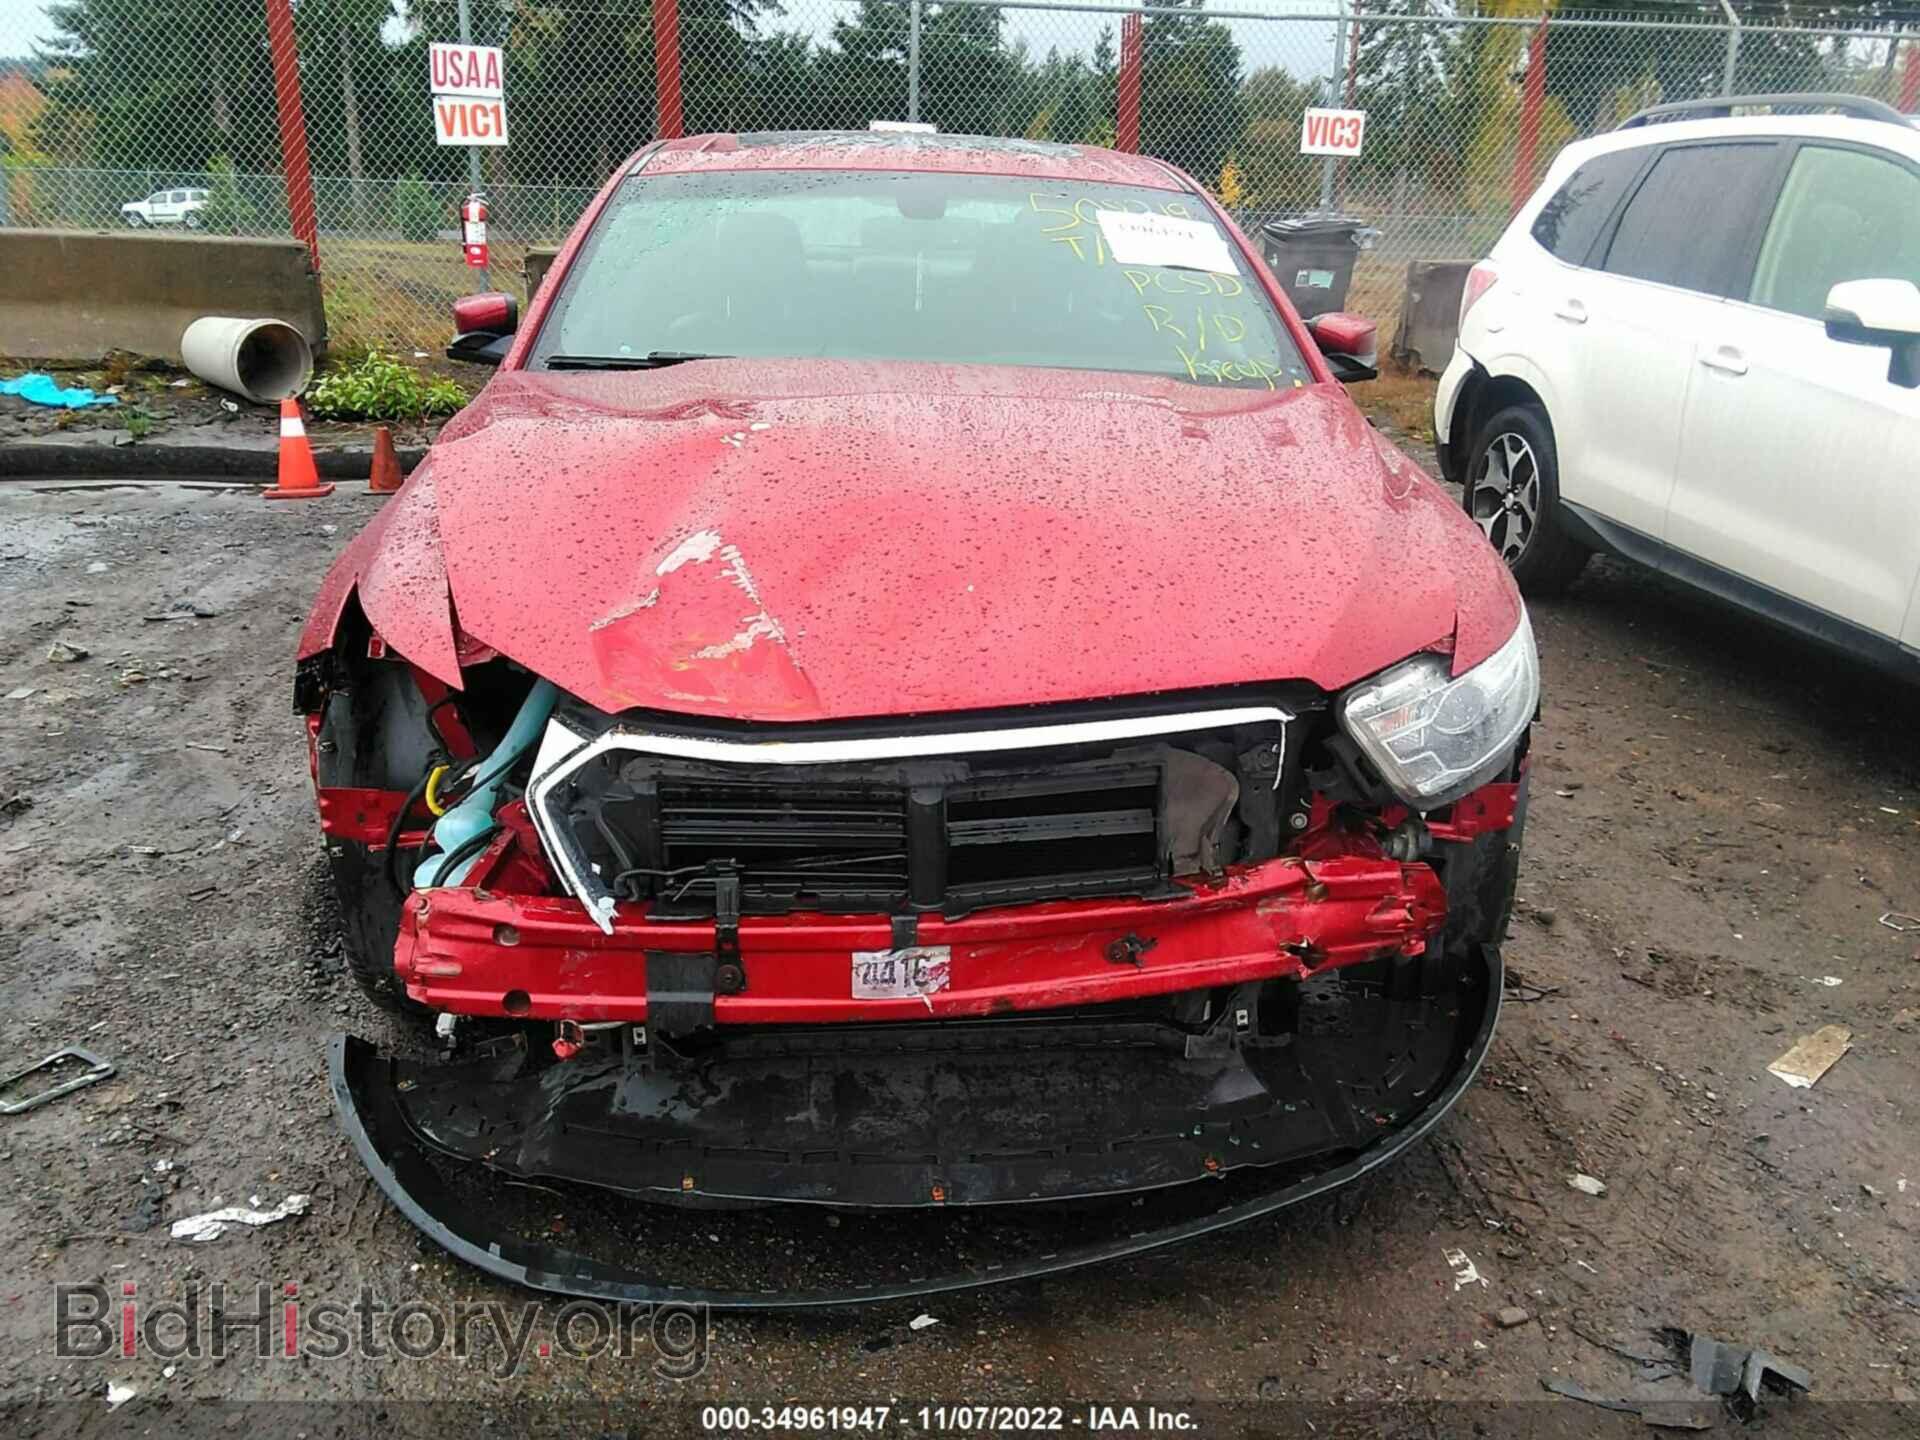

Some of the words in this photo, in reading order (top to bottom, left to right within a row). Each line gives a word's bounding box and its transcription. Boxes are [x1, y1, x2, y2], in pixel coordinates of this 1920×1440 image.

[432, 49, 500, 89] USAA
[438, 103, 503, 137] VIC1
[1307, 116, 1361, 149] VIC3
